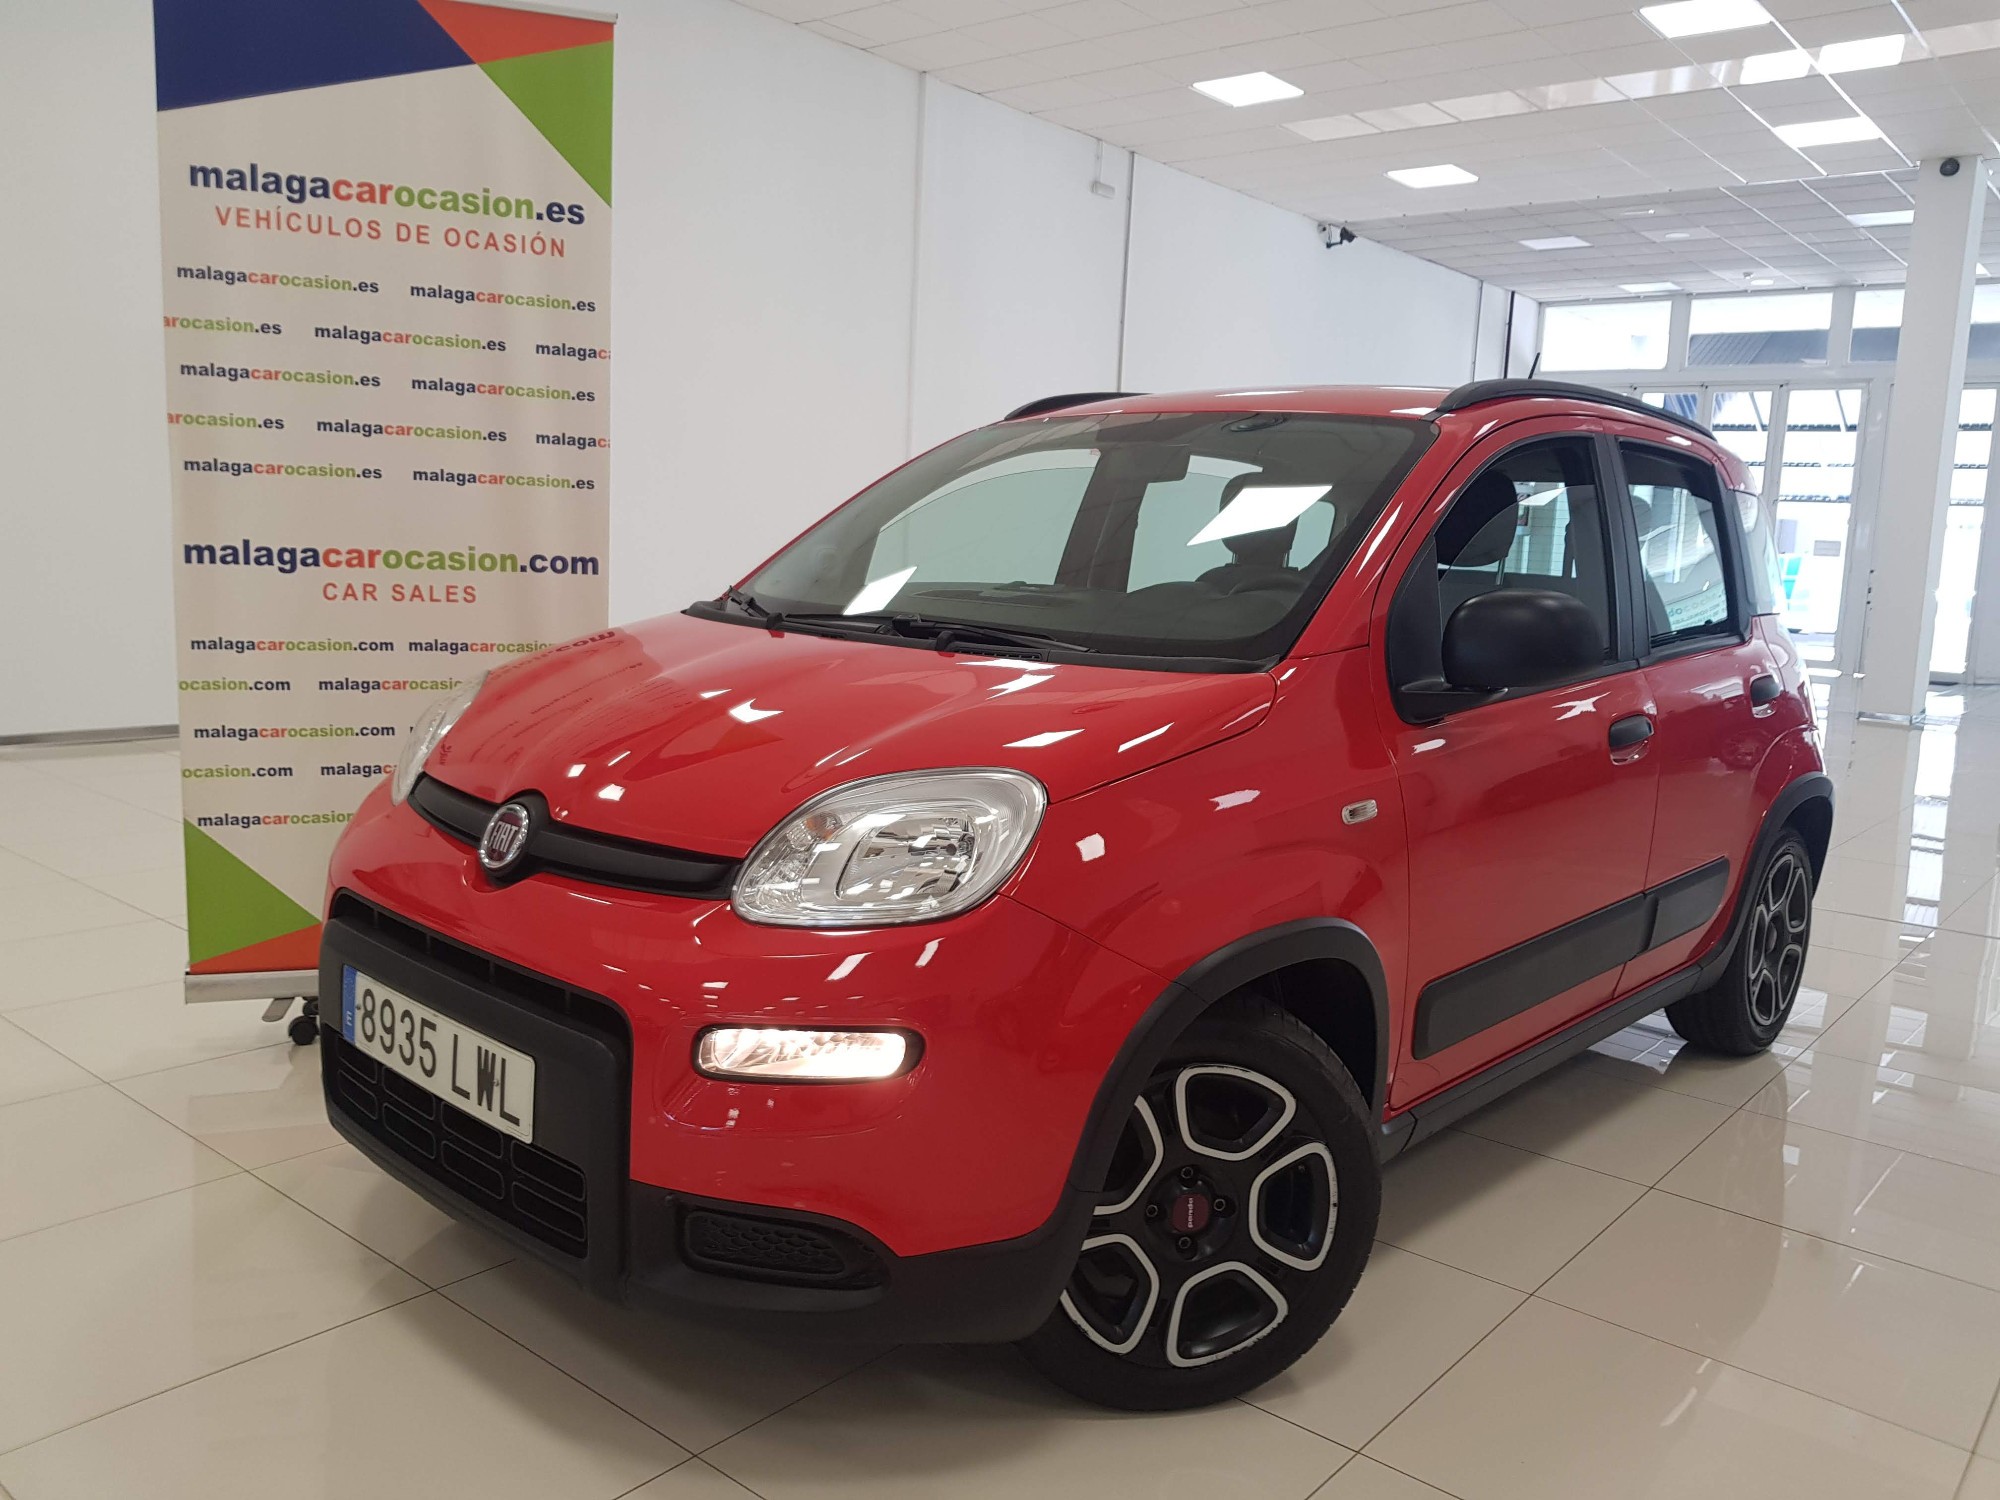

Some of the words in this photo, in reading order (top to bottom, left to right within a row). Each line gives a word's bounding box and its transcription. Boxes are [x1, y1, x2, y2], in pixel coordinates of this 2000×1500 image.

[189, 163, 585, 224] malagacarocasion.es
[215, 206, 382, 240] VEHÍCULOS
[397, 223, 430, 244] DE
[444, 228, 565, 258] OCASIÓN
[177, 264, 379, 294] malagacarocasion.es
[410, 284, 595, 312] malagacarocasion.es
[315, 325, 506, 352] malagacarocasion.es
[536, 342, 610, 360] malagac
[180, 362, 381, 388] malagacarocasion.es
[411, 377, 595, 402] malagacarocasion.es
[317, 419, 507, 442] malagacarocasion.es
[536, 432, 610, 449] malagac
[184, 458, 382, 479] malagacarocasion.es
[413, 469, 595, 490] malagacarocasion.es
[184, 539, 599, 575] malagacarocasion.com
[323, 583, 378, 601] CAR
[392, 585, 477, 604] SALES
[191, 637, 394, 654] malagacarocasion.com
[408, 639, 554, 654] malagacarocasio
[179, 678, 290, 691] ocasion.com
[194, 724, 395, 741] malagacarocasion.com
[182, 764, 292, 779] ocasion.com
[488, 821, 518, 852] FIAT
[361, 988, 437, 1078] 8935
[452, 1034, 520, 1127] LWL
